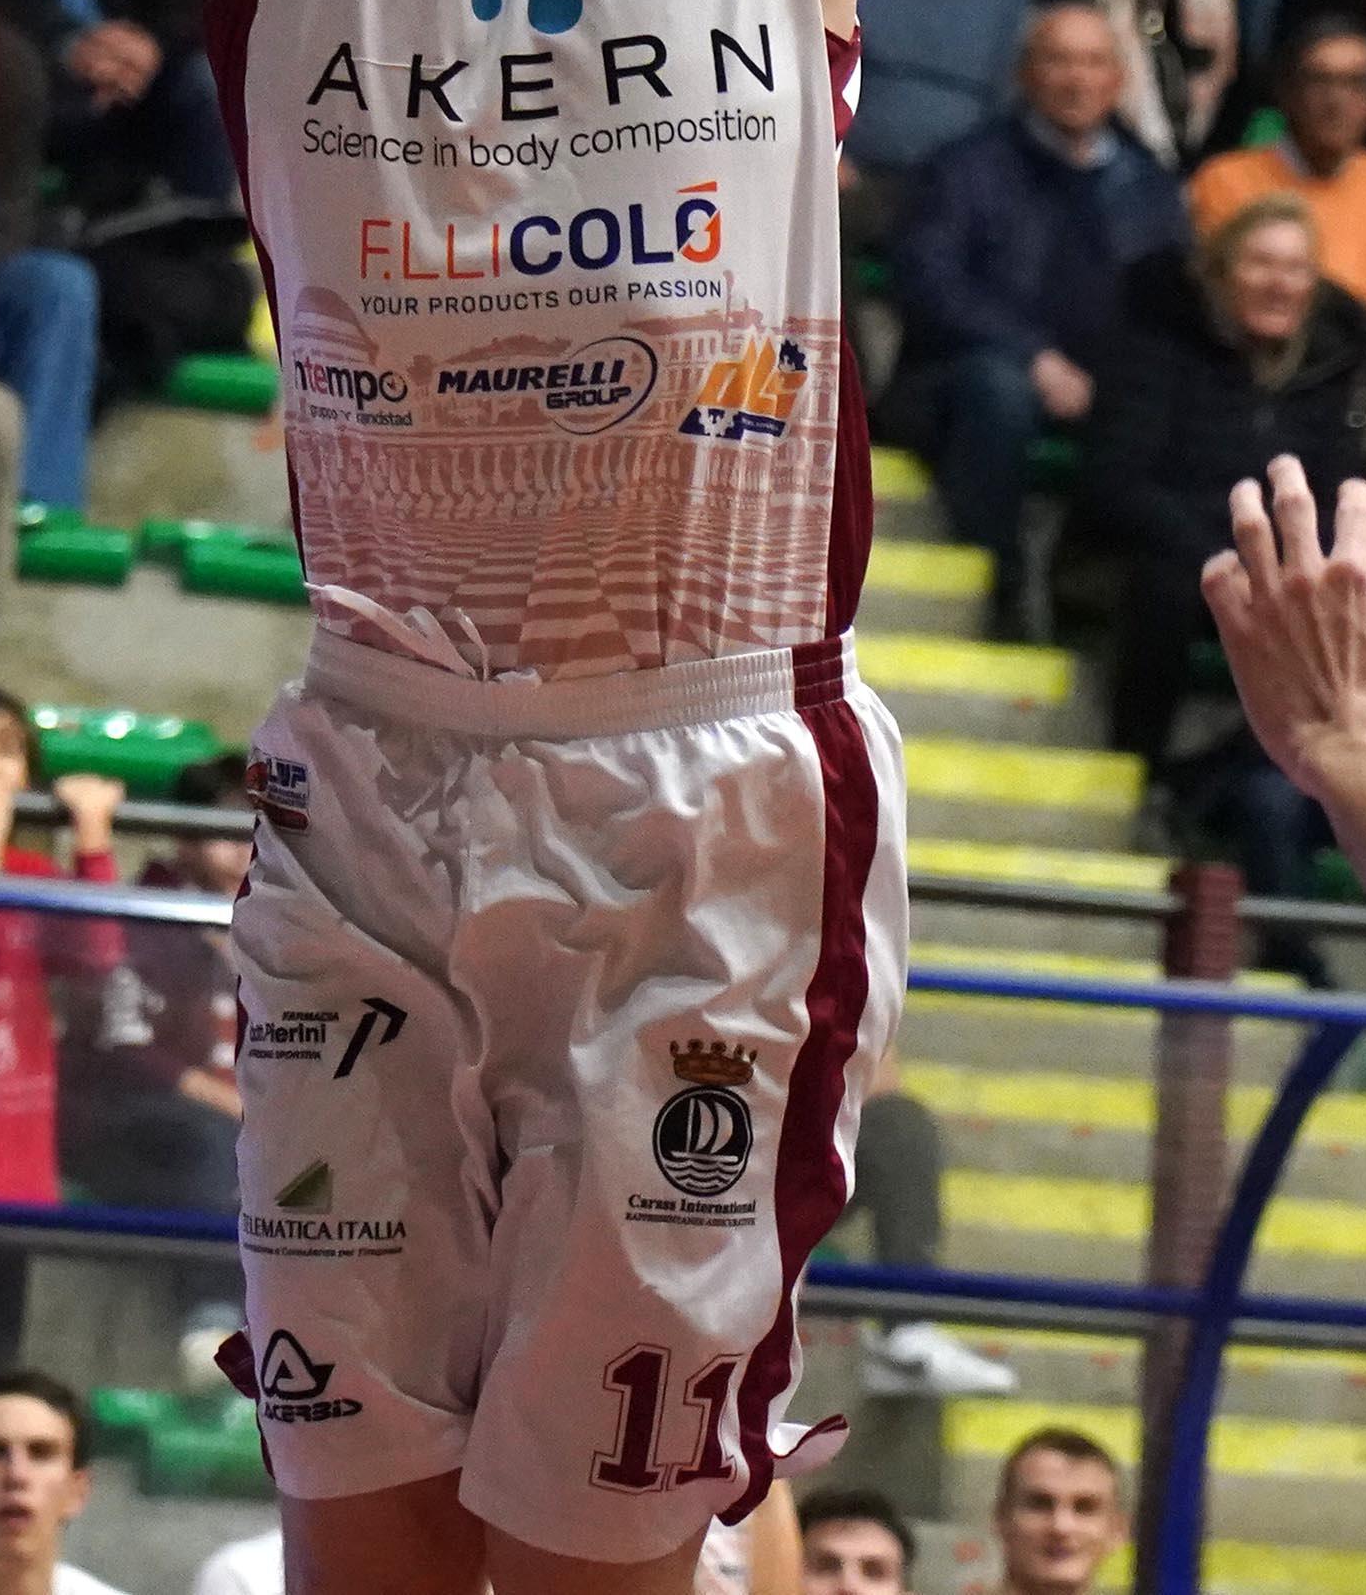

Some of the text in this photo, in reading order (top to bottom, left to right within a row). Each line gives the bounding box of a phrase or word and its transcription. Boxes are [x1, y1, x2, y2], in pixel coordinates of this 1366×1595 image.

[306, 23, 776, 123] AKERN
[302, 108, 777, 172] Science in body composition
[360, 278, 724, 317] YOUR PRODUCTS OUR PASSION
[436, 358, 626, 395] MAURELLI
[545, 385, 633, 411] GROUP
[337, 1218, 407, 1241] ITALIA
[589, 1342, 746, 1495] 11
